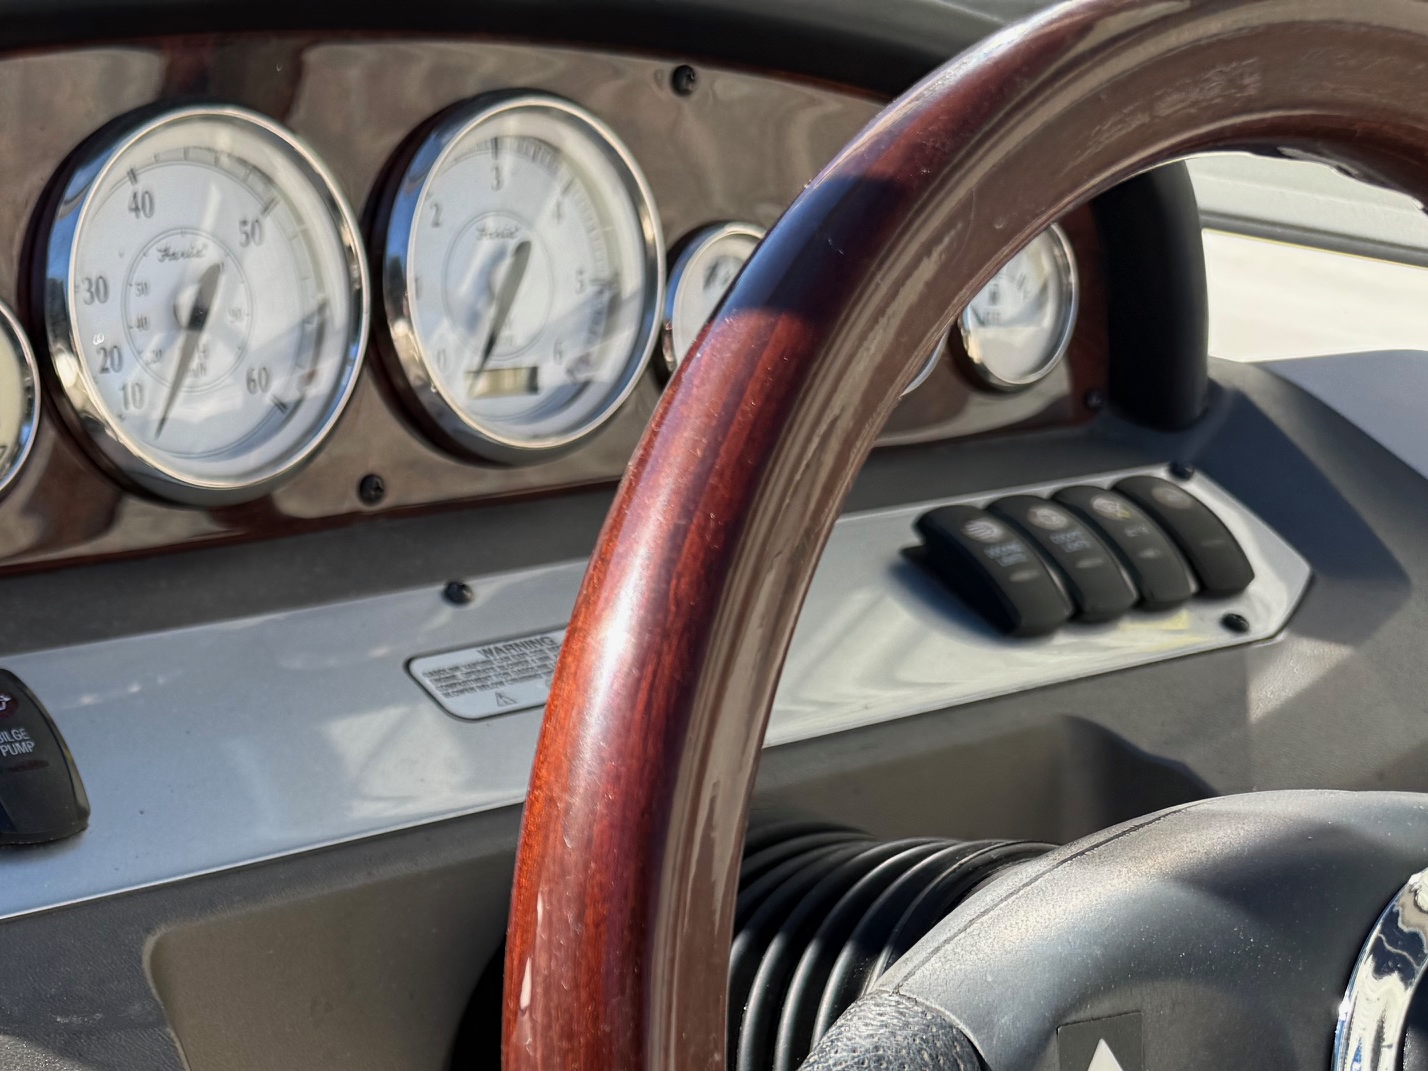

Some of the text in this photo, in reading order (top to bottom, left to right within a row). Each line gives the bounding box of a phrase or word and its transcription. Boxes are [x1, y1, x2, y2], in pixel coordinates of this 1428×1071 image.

[128, 190, 154, 218] 40
[238, 219, 264, 247] 50
[82, 276, 108, 305] 30
[97, 345, 122, 374] 20
[246, 366, 269, 394] 60
[120, 382, 144, 411] 10
[477, 637, 557, 660] WARNING
[0, 741, 35, 757] PUMP
